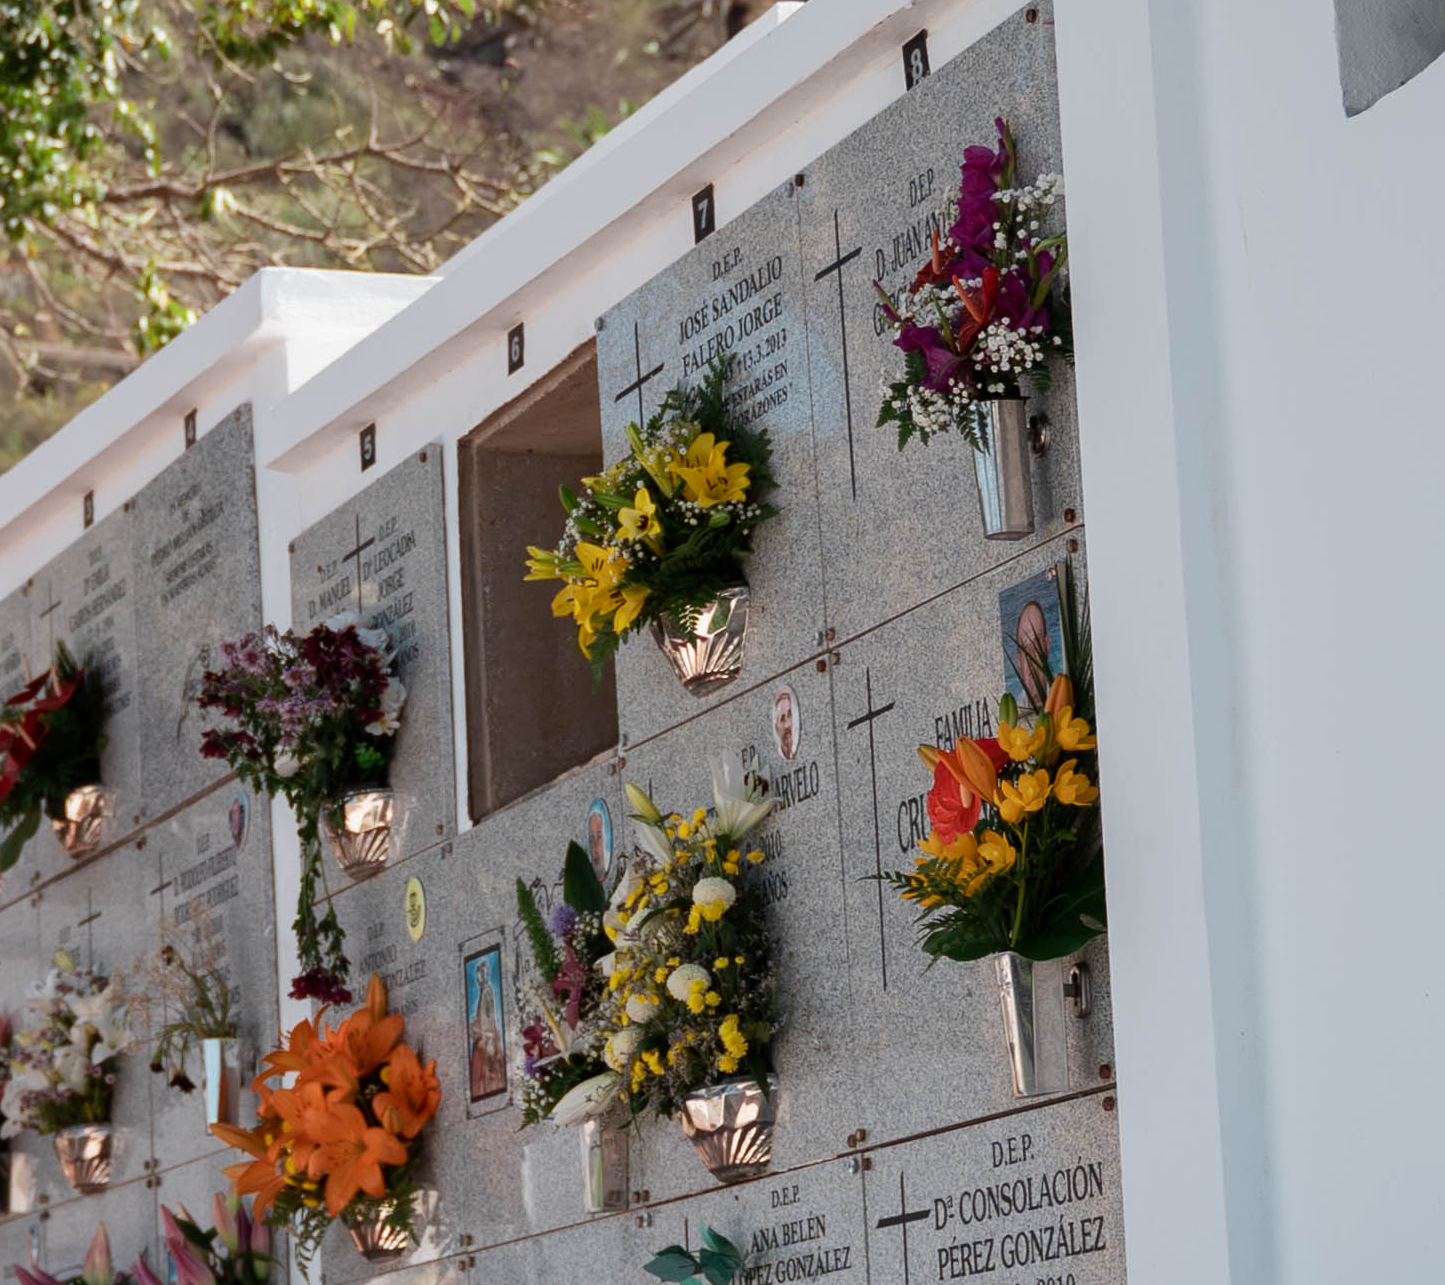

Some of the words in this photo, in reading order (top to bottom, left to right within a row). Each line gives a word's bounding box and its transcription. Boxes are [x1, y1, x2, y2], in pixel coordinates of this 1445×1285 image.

[910, 47, 923, 75] 8
[697, 198, 709, 230] 7
[891, 220, 922, 273] JUAN
[678, 299, 709, 346] JOSÉ
[711, 255, 783, 322] SANDALIO
[512, 336, 520, 363] 6
[681, 325, 736, 378] FALERO
[737, 292, 784, 342] JORGE
[363, 434, 372, 460] 5
[377, 566, 406, 603] JORGE
[991, 1133, 1035, 1169] D.E.P.
[771, 1184, 801, 1209] D.E.P.
[959, 1155, 1104, 1225] CONSOLACIÓN
[751, 1227, 780, 1254] ANA
[782, 1210, 827, 1247] BELÉN
[937, 1235, 996, 1281] PÉREZ
[1000, 1213, 1107, 1269] GONZÁLEZ
[775, 1245, 852, 1285] GONZÁLEZ
